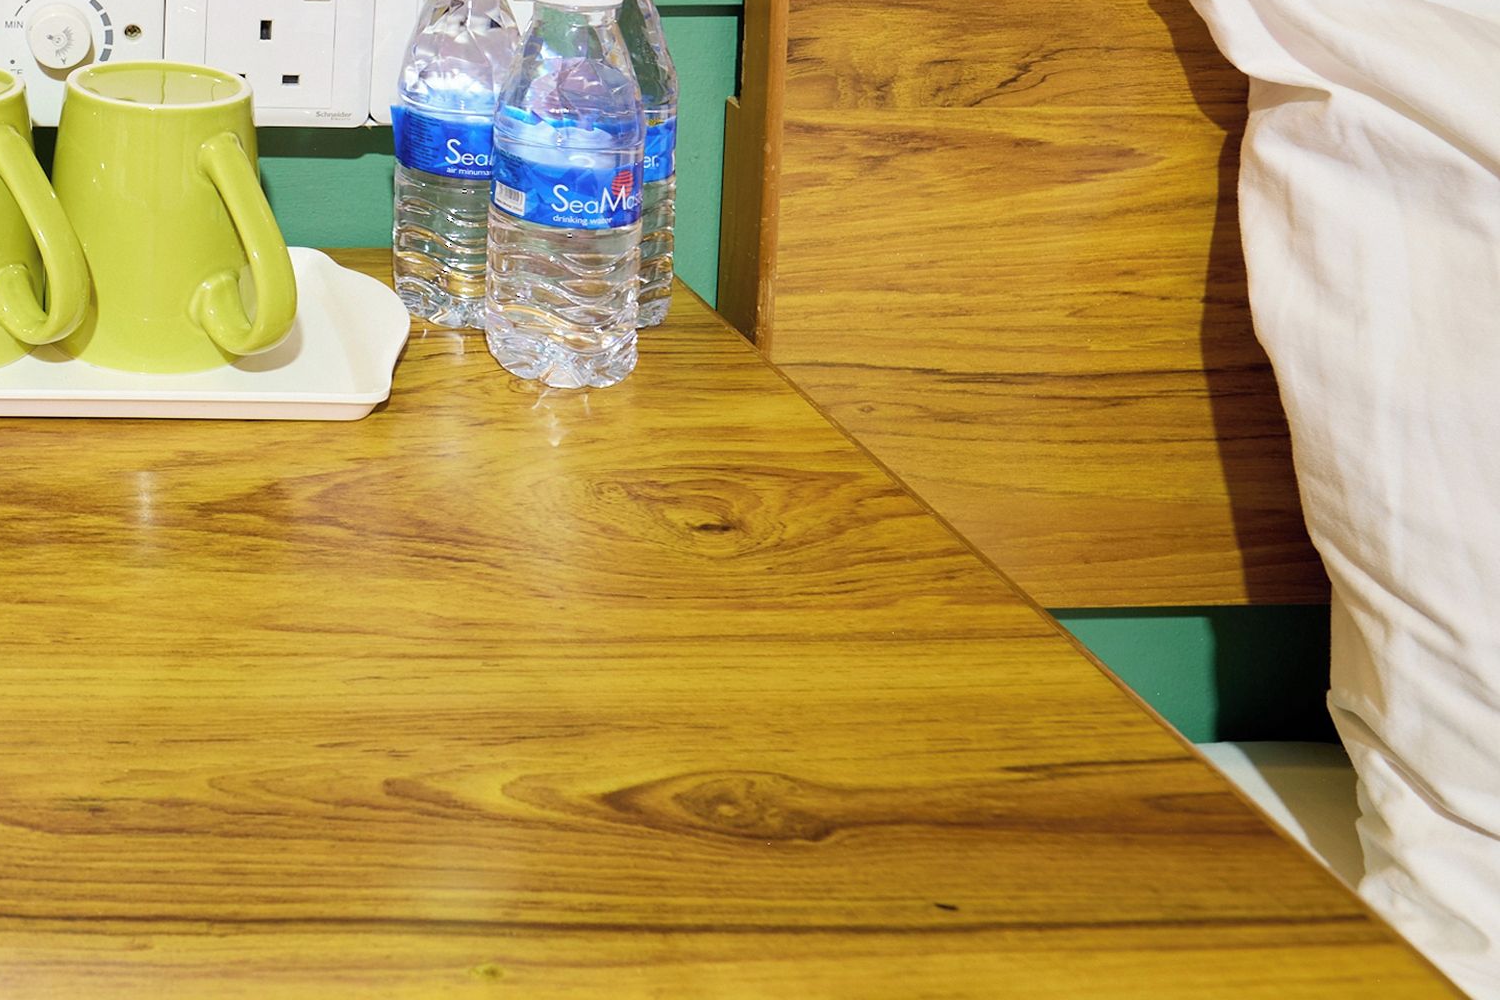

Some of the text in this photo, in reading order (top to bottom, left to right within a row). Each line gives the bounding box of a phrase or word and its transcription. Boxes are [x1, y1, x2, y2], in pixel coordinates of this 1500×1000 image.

[4, 21, 24, 29] MIN
[458, 169, 494, 177] minuma
[552, 215, 613, 226] drinking water
